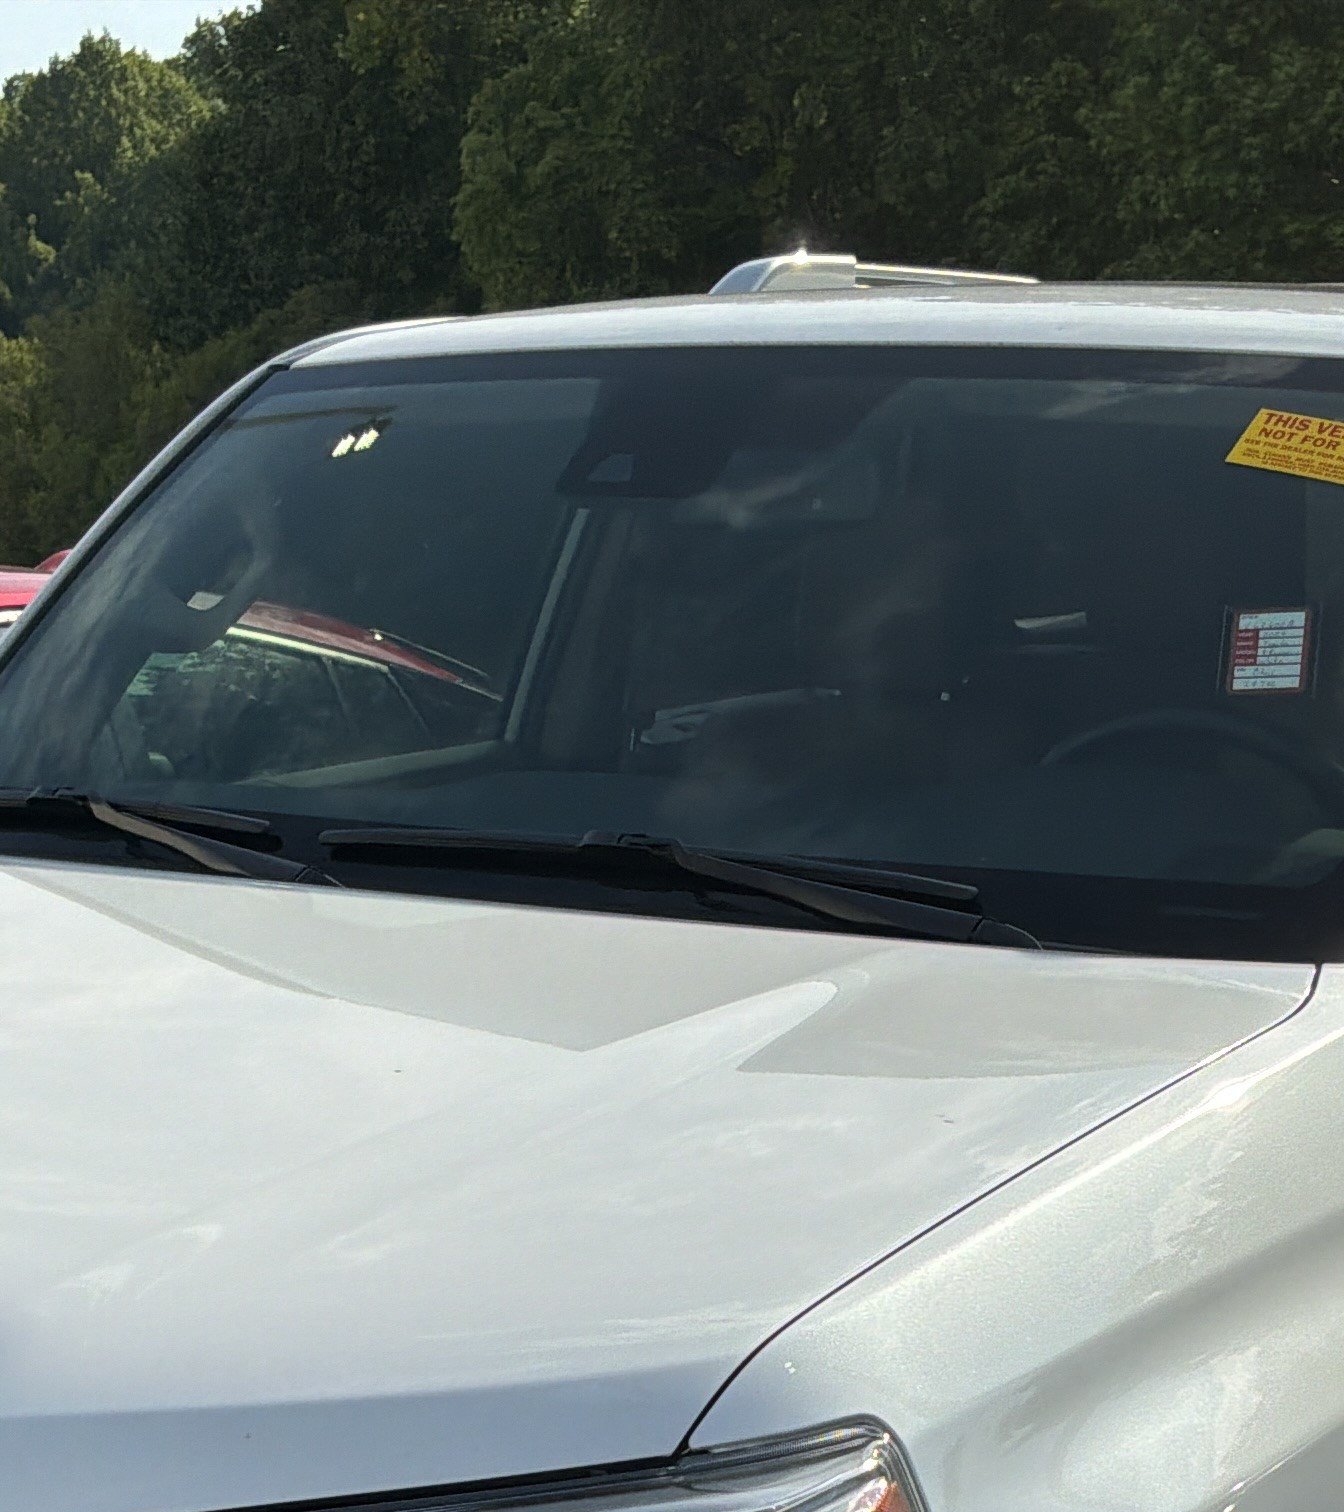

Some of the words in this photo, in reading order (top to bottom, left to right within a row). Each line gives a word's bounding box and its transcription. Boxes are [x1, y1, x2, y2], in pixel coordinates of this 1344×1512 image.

[1262, 412, 1312, 432] THIS
[1258, 427, 1299, 445] NOT
[1300, 435, 1341, 451] FOR
